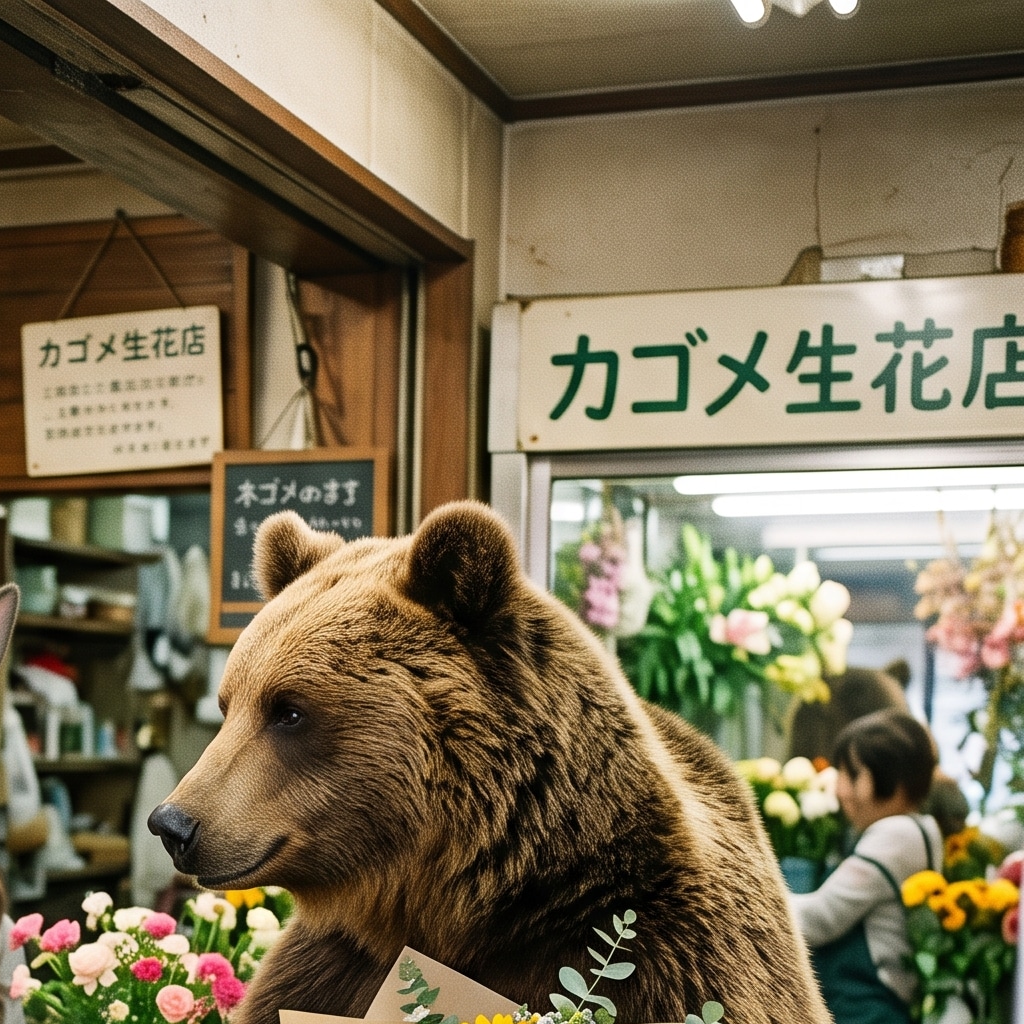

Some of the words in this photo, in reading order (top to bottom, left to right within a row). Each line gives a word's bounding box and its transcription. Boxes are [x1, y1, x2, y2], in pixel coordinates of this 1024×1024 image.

[38, 322, 206, 369] カゴメ生花店
[548, 312, 1024, 422] カゴメ生花店
